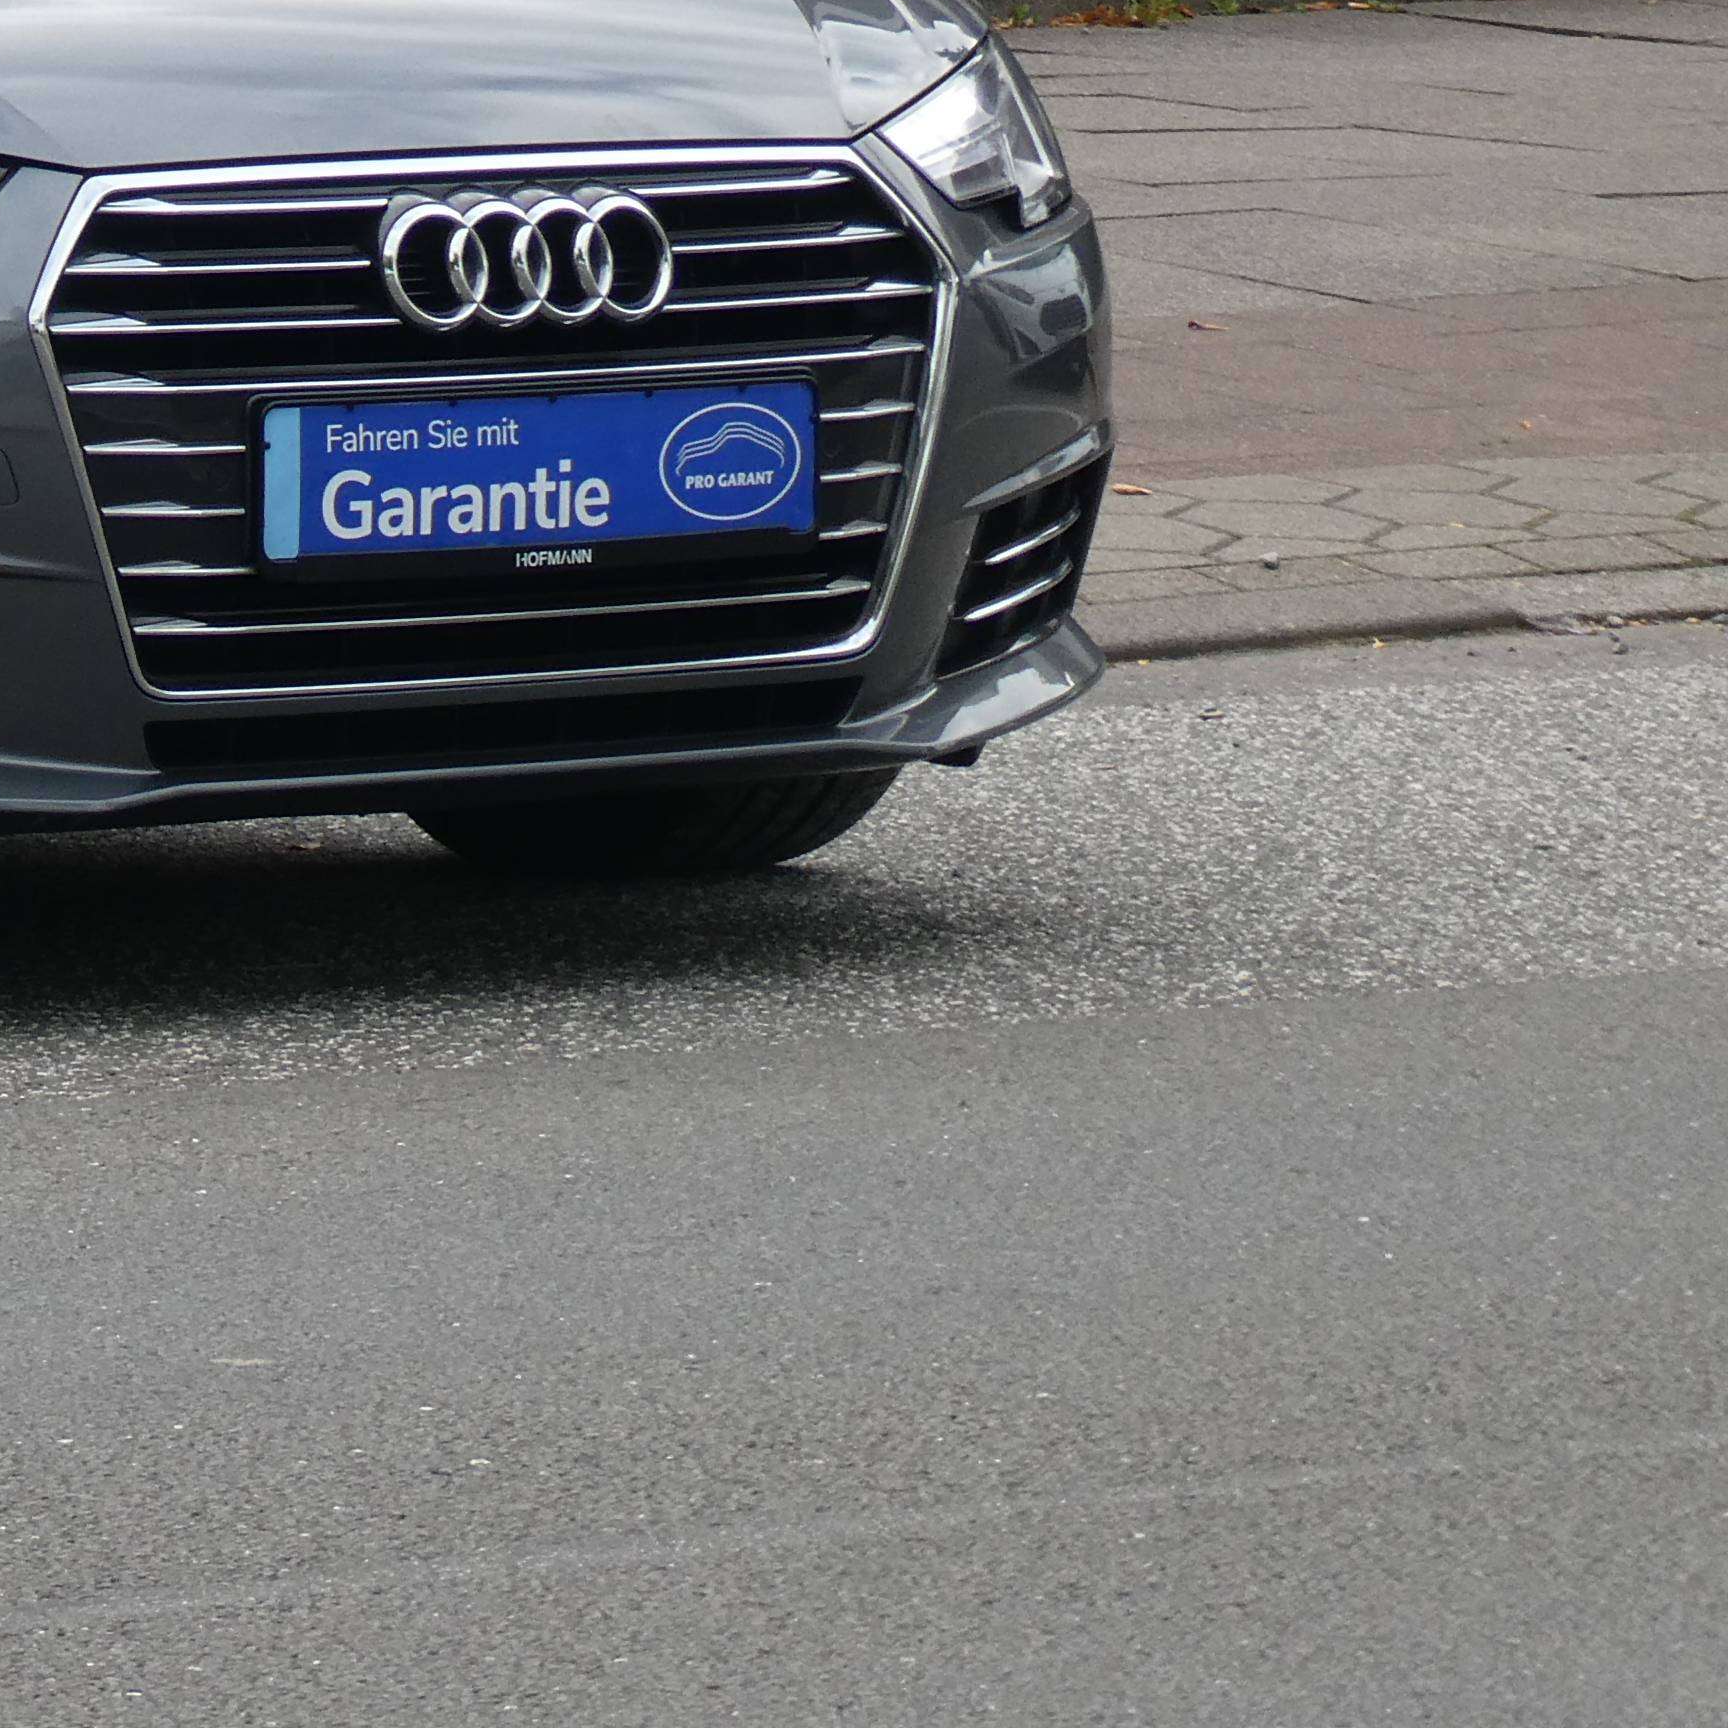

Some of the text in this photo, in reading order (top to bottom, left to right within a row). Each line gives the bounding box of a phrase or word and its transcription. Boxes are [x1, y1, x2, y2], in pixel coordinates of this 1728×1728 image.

[325, 416, 520, 454] Fahren Sie mit
[685, 469, 775, 491] PRO GARANT
[321, 458, 611, 541] Garantie
[515, 548, 593, 568] HOFMANN
